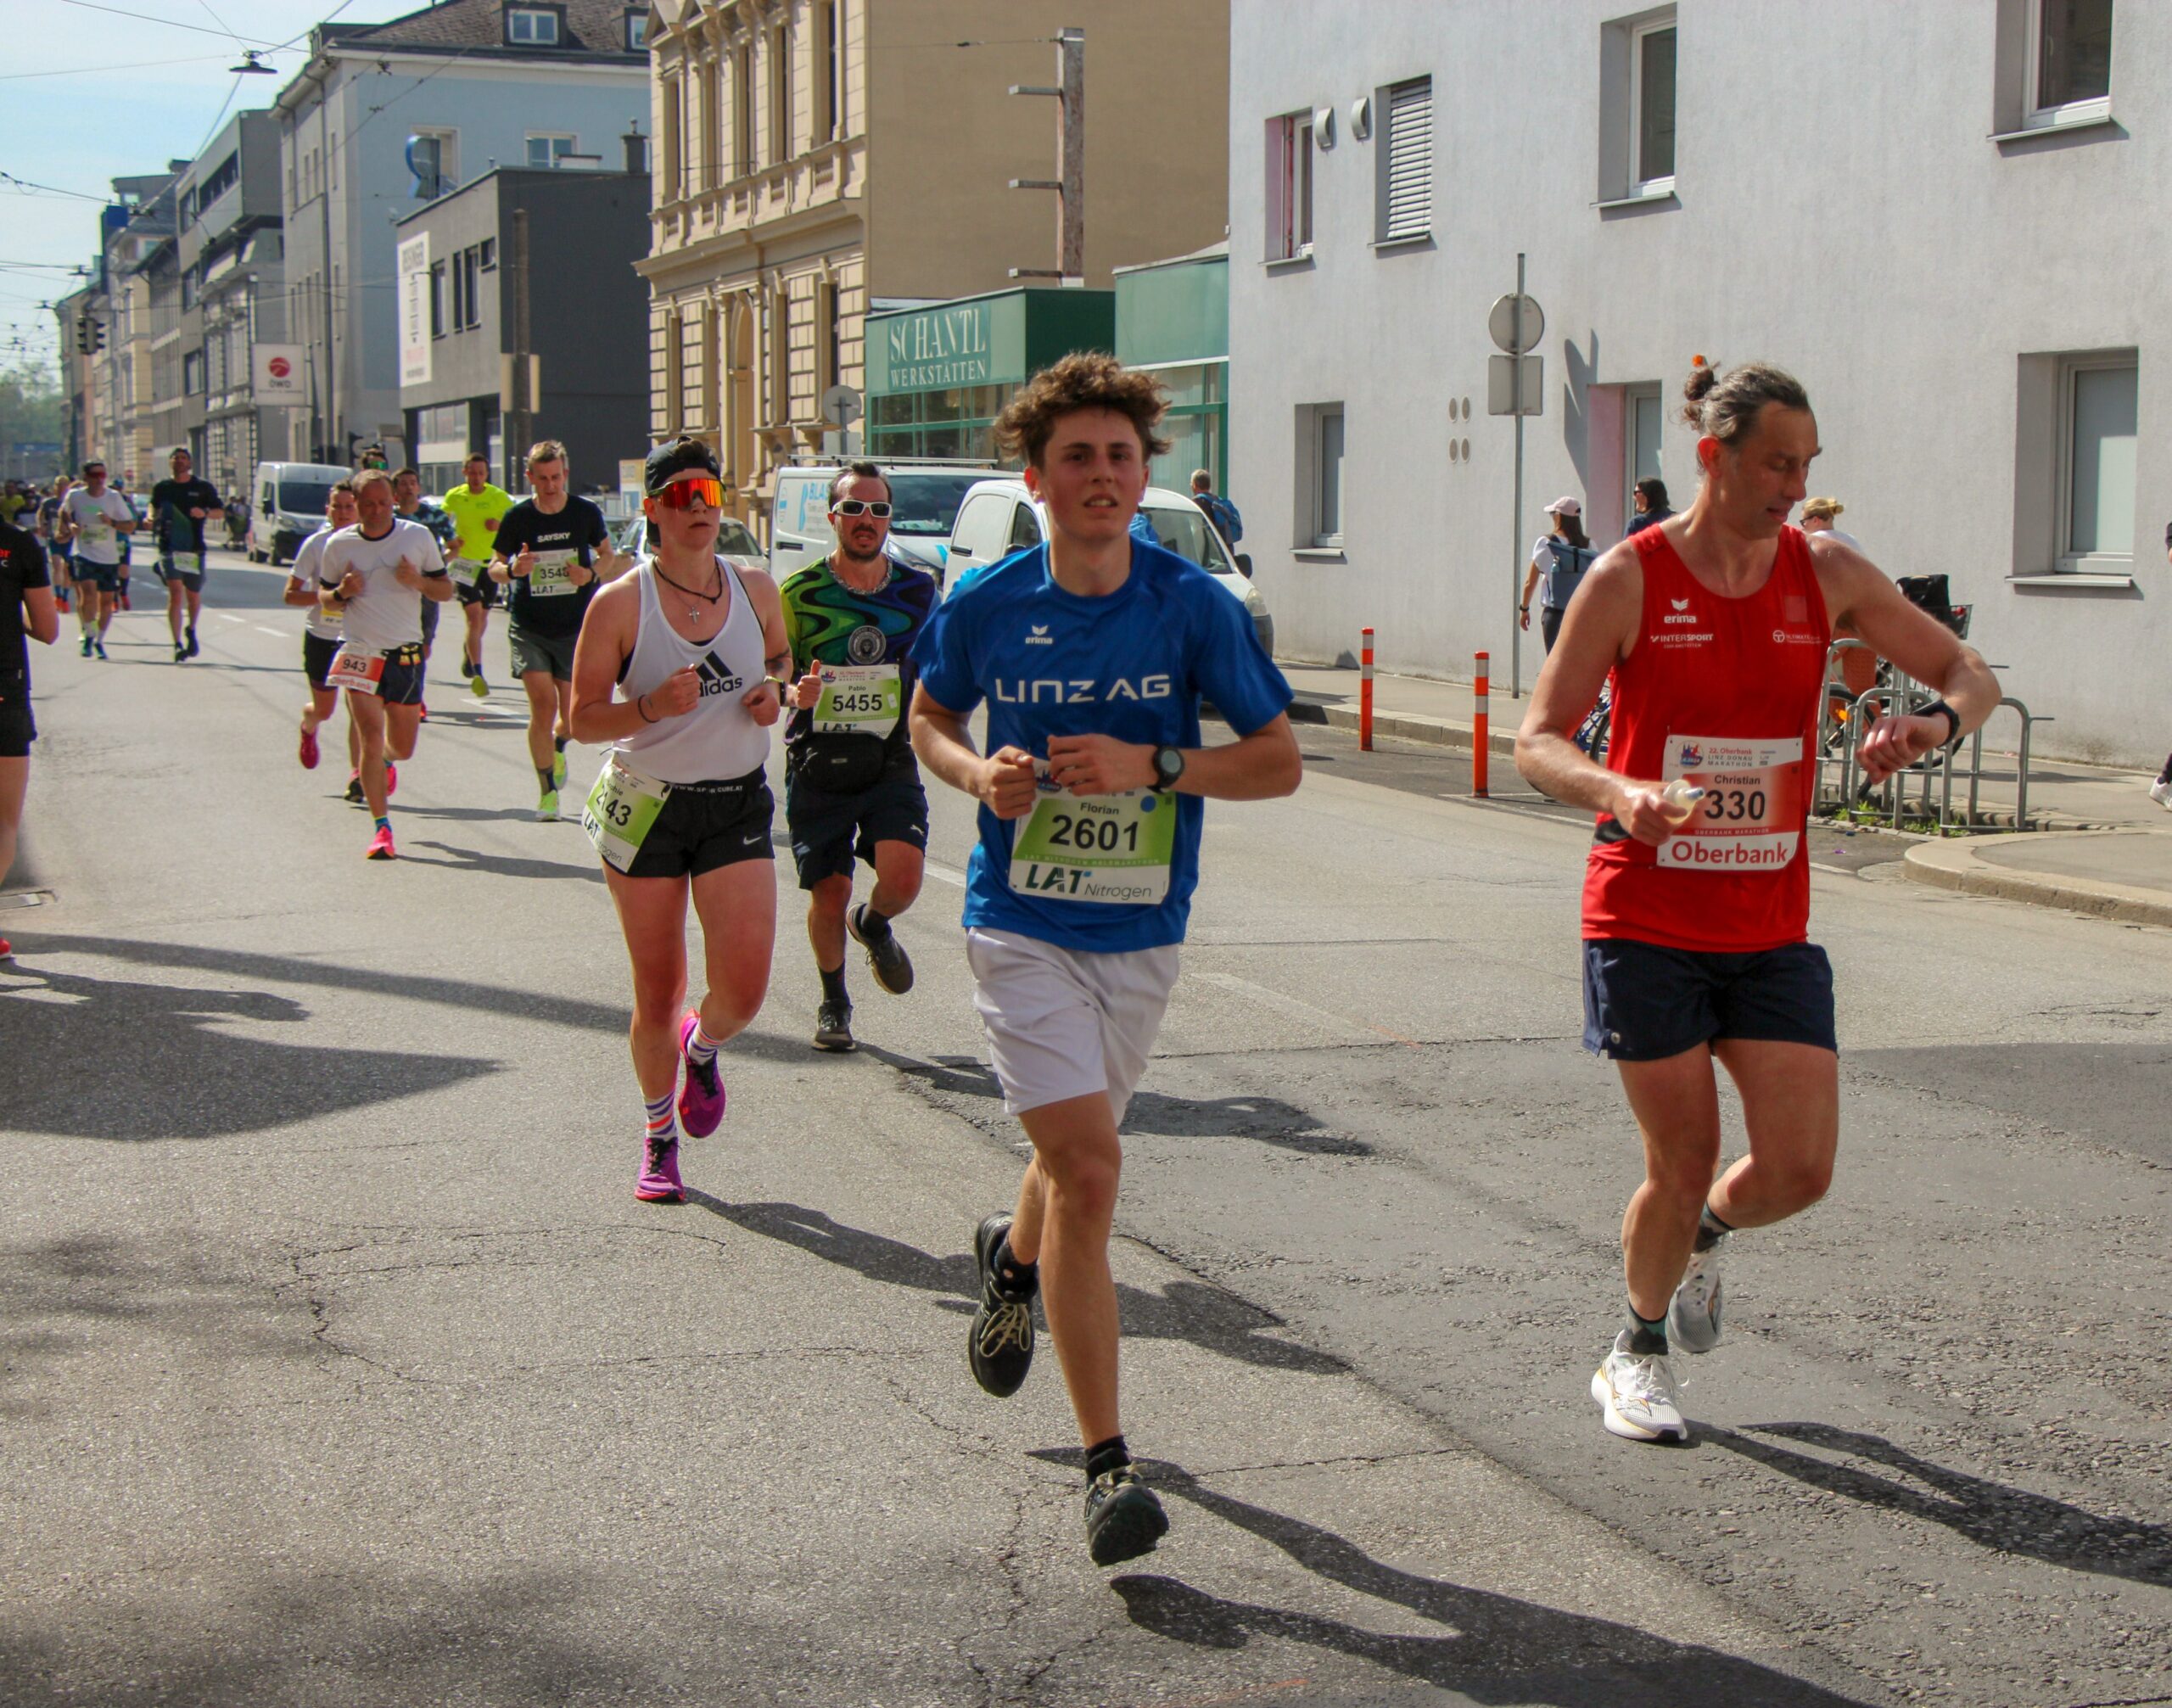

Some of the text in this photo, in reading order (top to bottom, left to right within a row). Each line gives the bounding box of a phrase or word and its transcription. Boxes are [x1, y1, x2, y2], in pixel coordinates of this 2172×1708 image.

[890, 308, 986, 363] SCHANTL
[891, 359, 986, 388] WERKSTÄTTEN
[537, 532, 571, 543] SAYSKY
[1664, 613, 1697, 624] erima
[1025, 636, 1053, 645] erima
[1660, 633, 1714, 642] INTERSPORT
[343, 658, 367, 673] 943
[699, 677, 743, 697] idas
[1106, 675, 1170, 701] AG
[832, 693, 883, 713] 5455
[1714, 774, 1761, 786] Christian
[1080, 802, 1119, 815] Florian
[1704, 789, 1766, 820] 330
[1049, 815, 1139, 852] 2601
[1671, 840, 1788, 865] Oberbank
[1025, 864, 1152, 901] LAT Nitrogen
